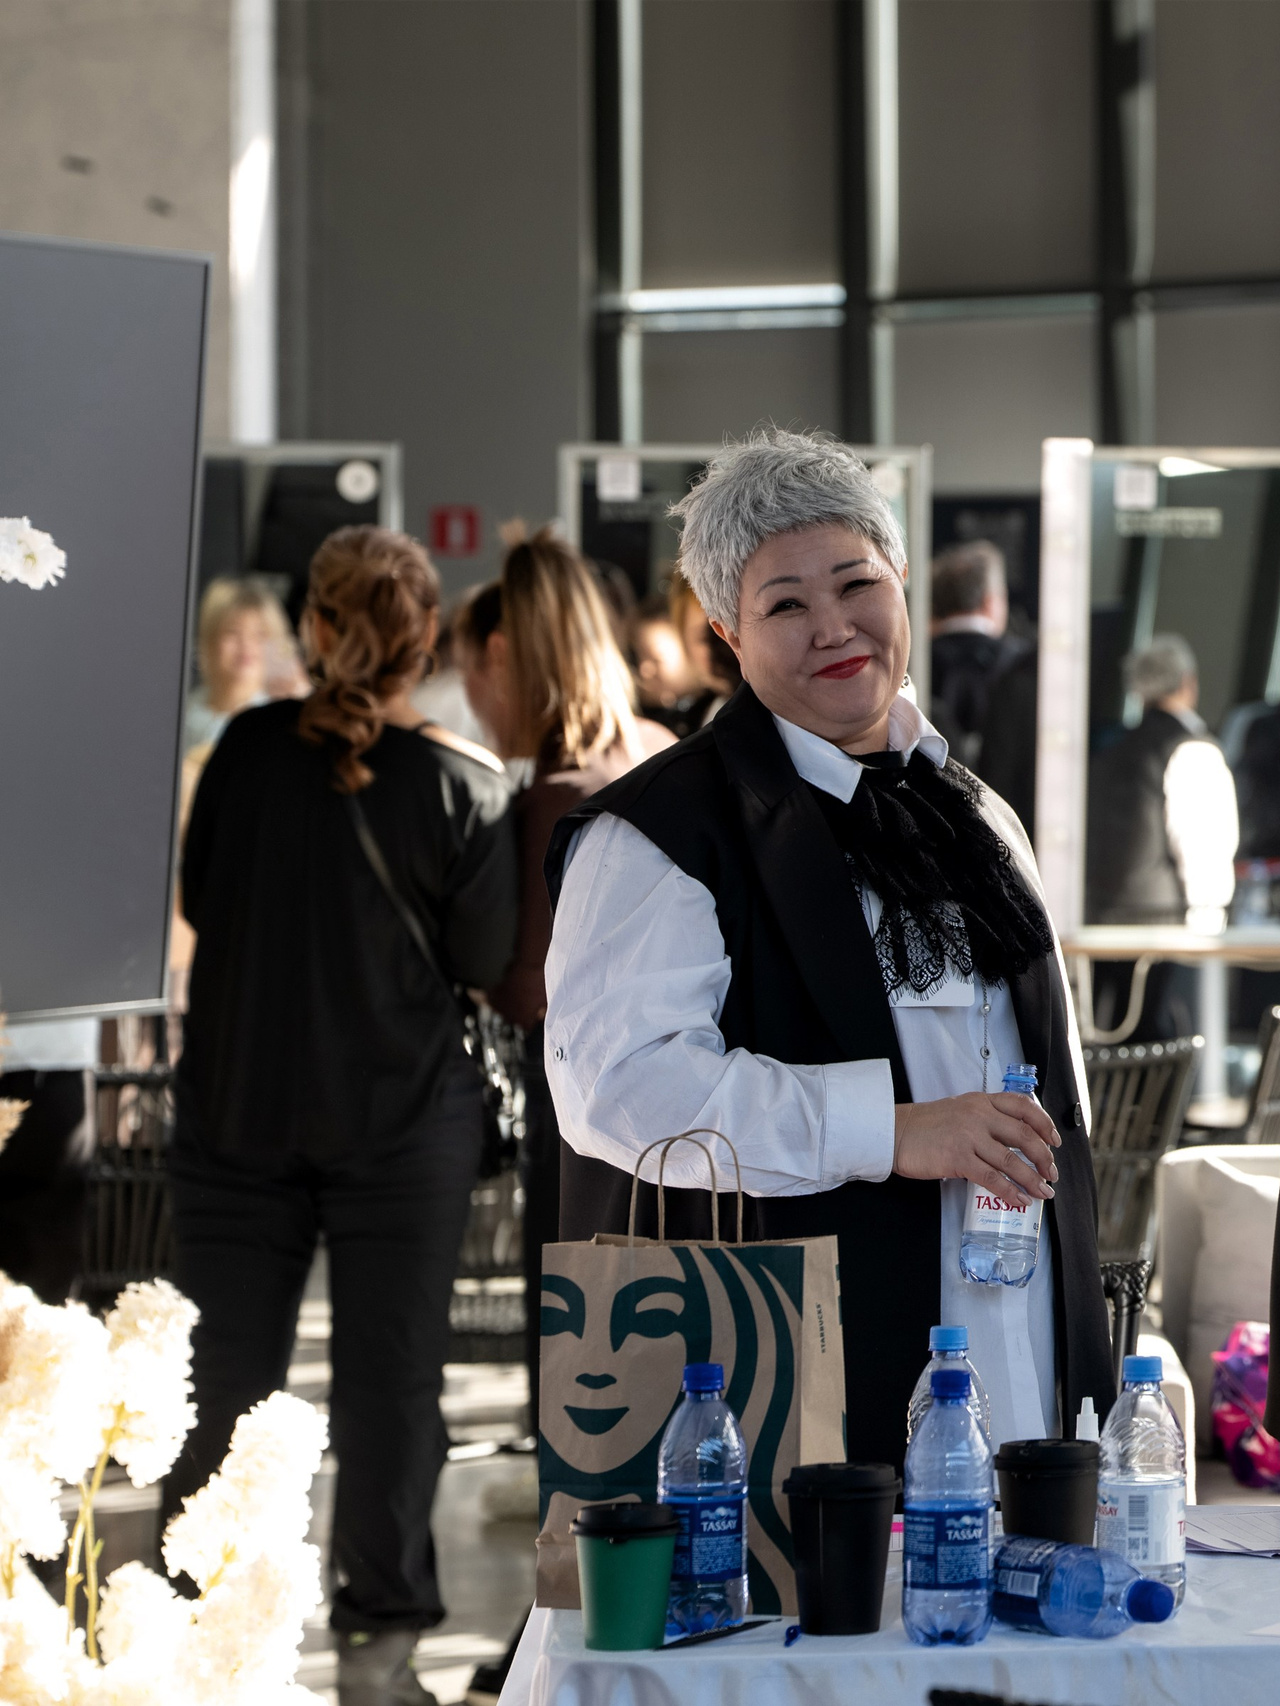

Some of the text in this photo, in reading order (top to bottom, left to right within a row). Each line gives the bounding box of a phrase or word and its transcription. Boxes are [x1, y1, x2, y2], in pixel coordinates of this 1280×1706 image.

[815, 1303, 827, 1355] STARBUCKS
[700, 1519, 738, 1532] TASSAY
[946, 1528, 984, 1541] TASSAY
